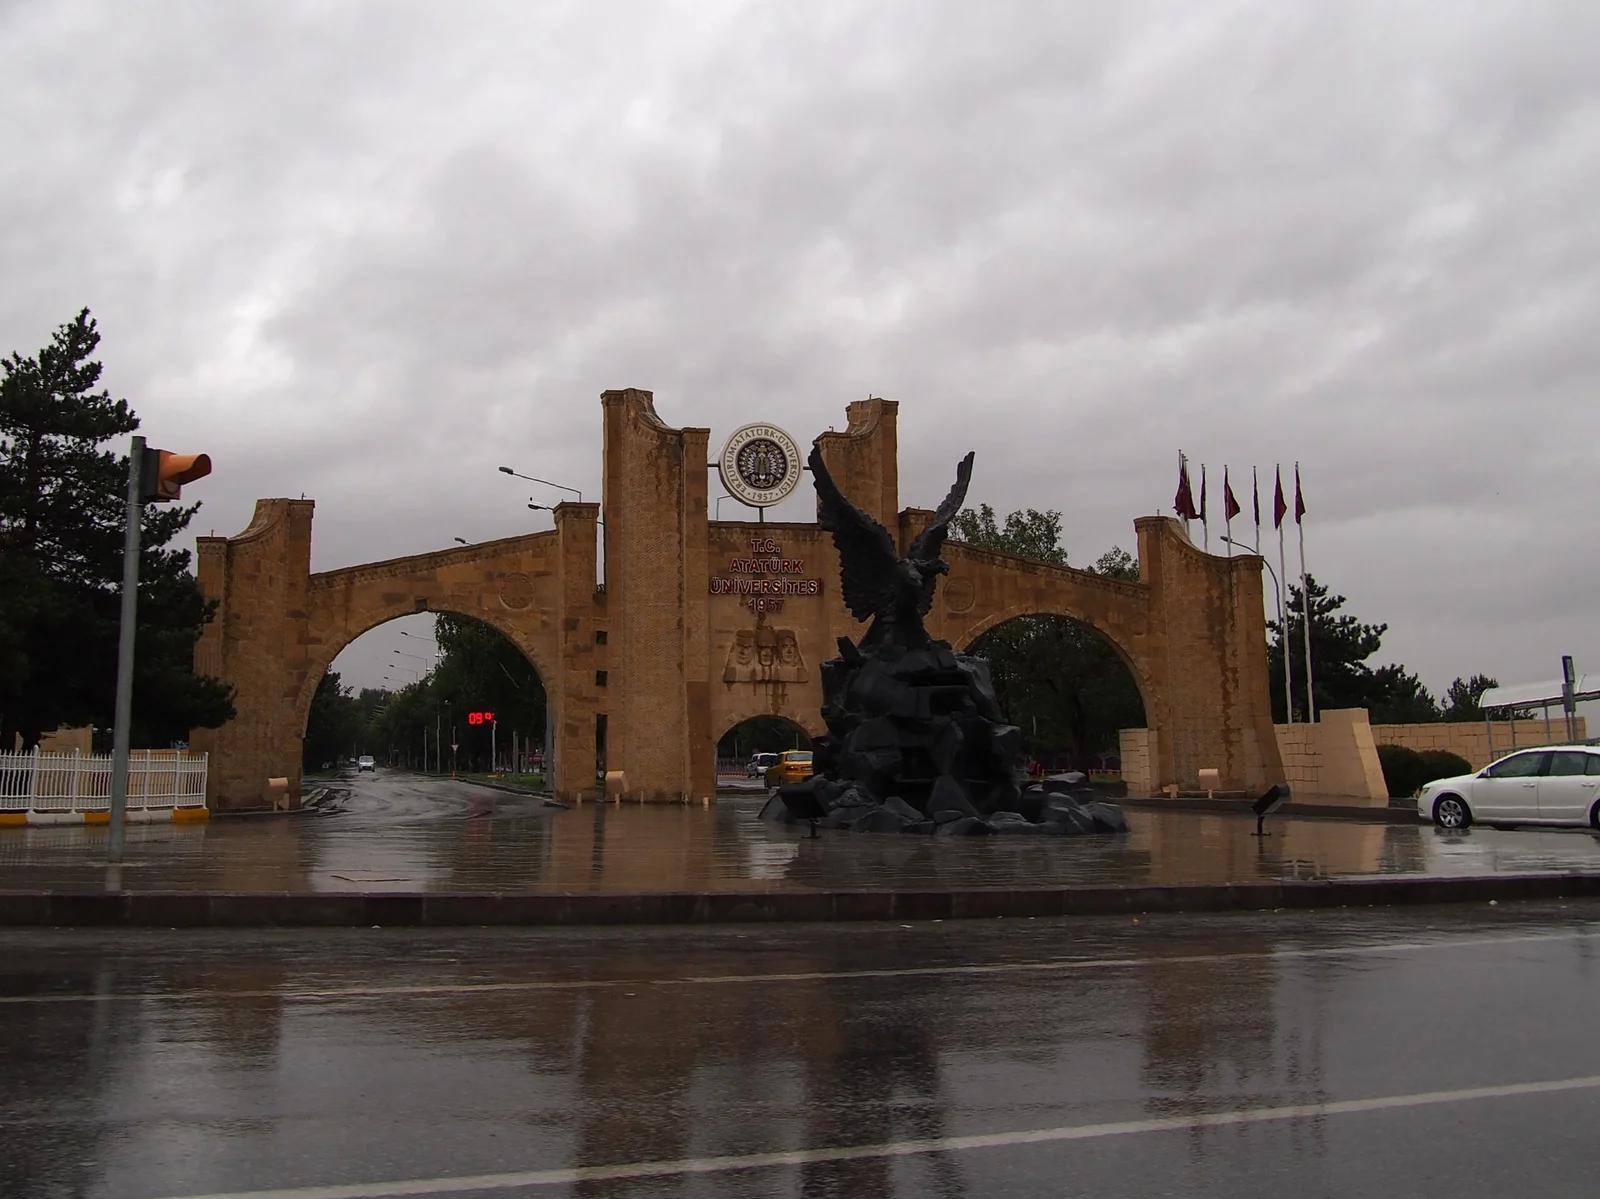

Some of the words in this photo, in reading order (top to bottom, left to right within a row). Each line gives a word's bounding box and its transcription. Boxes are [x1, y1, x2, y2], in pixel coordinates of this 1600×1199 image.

[735, 428, 777, 446] ATATÜRK
[726, 446, 746, 493] ERZURUM
[752, 492, 773, 500] 1957
[751, 539, 780, 552] T.C.
[729, 557, 803, 573] ATATÜRK
[709, 577, 824, 595] ÜNİVERSİTESİ
[748, 598, 785, 613] 1957
